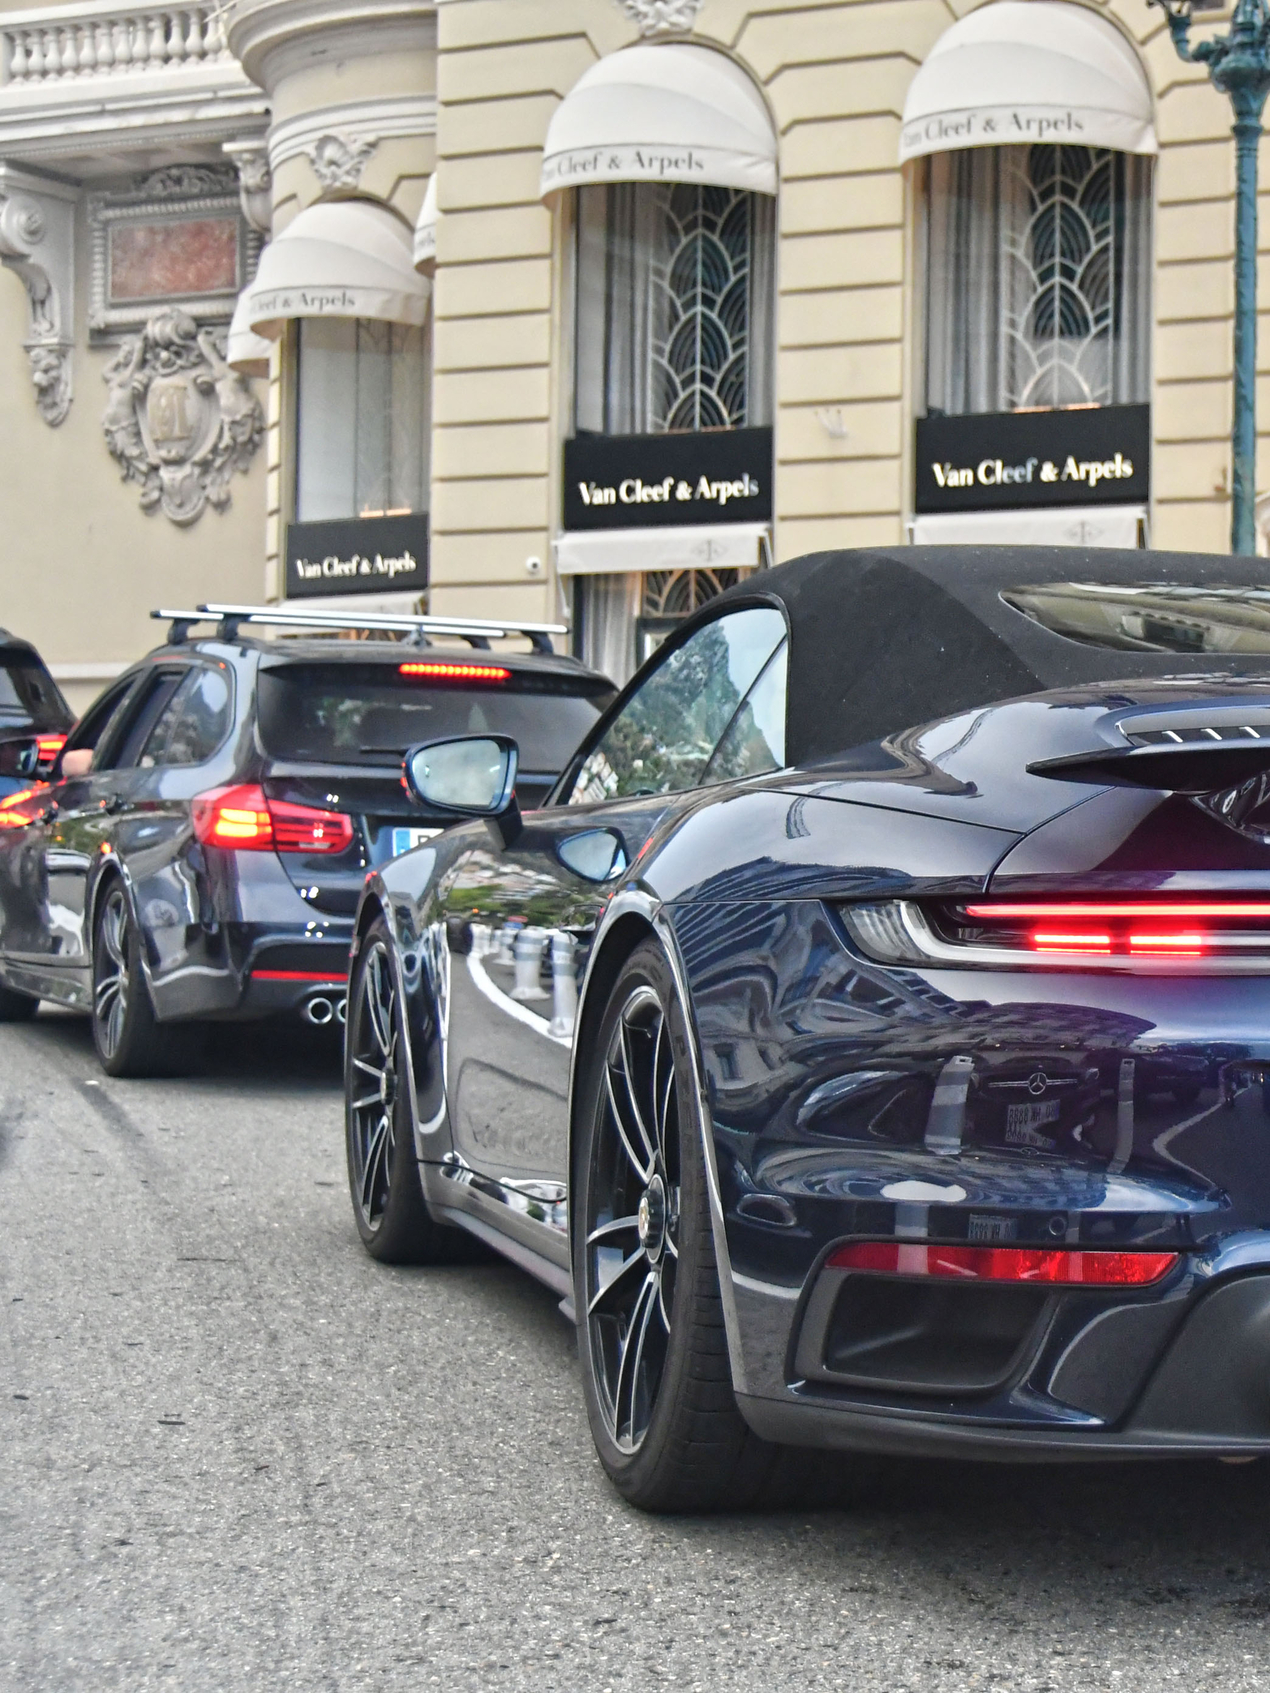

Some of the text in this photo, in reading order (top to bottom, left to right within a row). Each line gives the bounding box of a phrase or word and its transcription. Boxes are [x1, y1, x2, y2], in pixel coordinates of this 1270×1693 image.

[925, 112, 977, 139] Cleef
[983, 116, 997, 133] &
[1009, 112, 1084, 138] Arpels
[607, 155, 621, 170] &
[633, 150, 704, 176] Arpels
[299, 290, 356, 313] Arpels
[931, 452, 1134, 488] Van Cleef & Arpels
[578, 472, 759, 506] Van Cleef & Arpels
[296, 550, 417, 579] Van Cleef & Arpels
